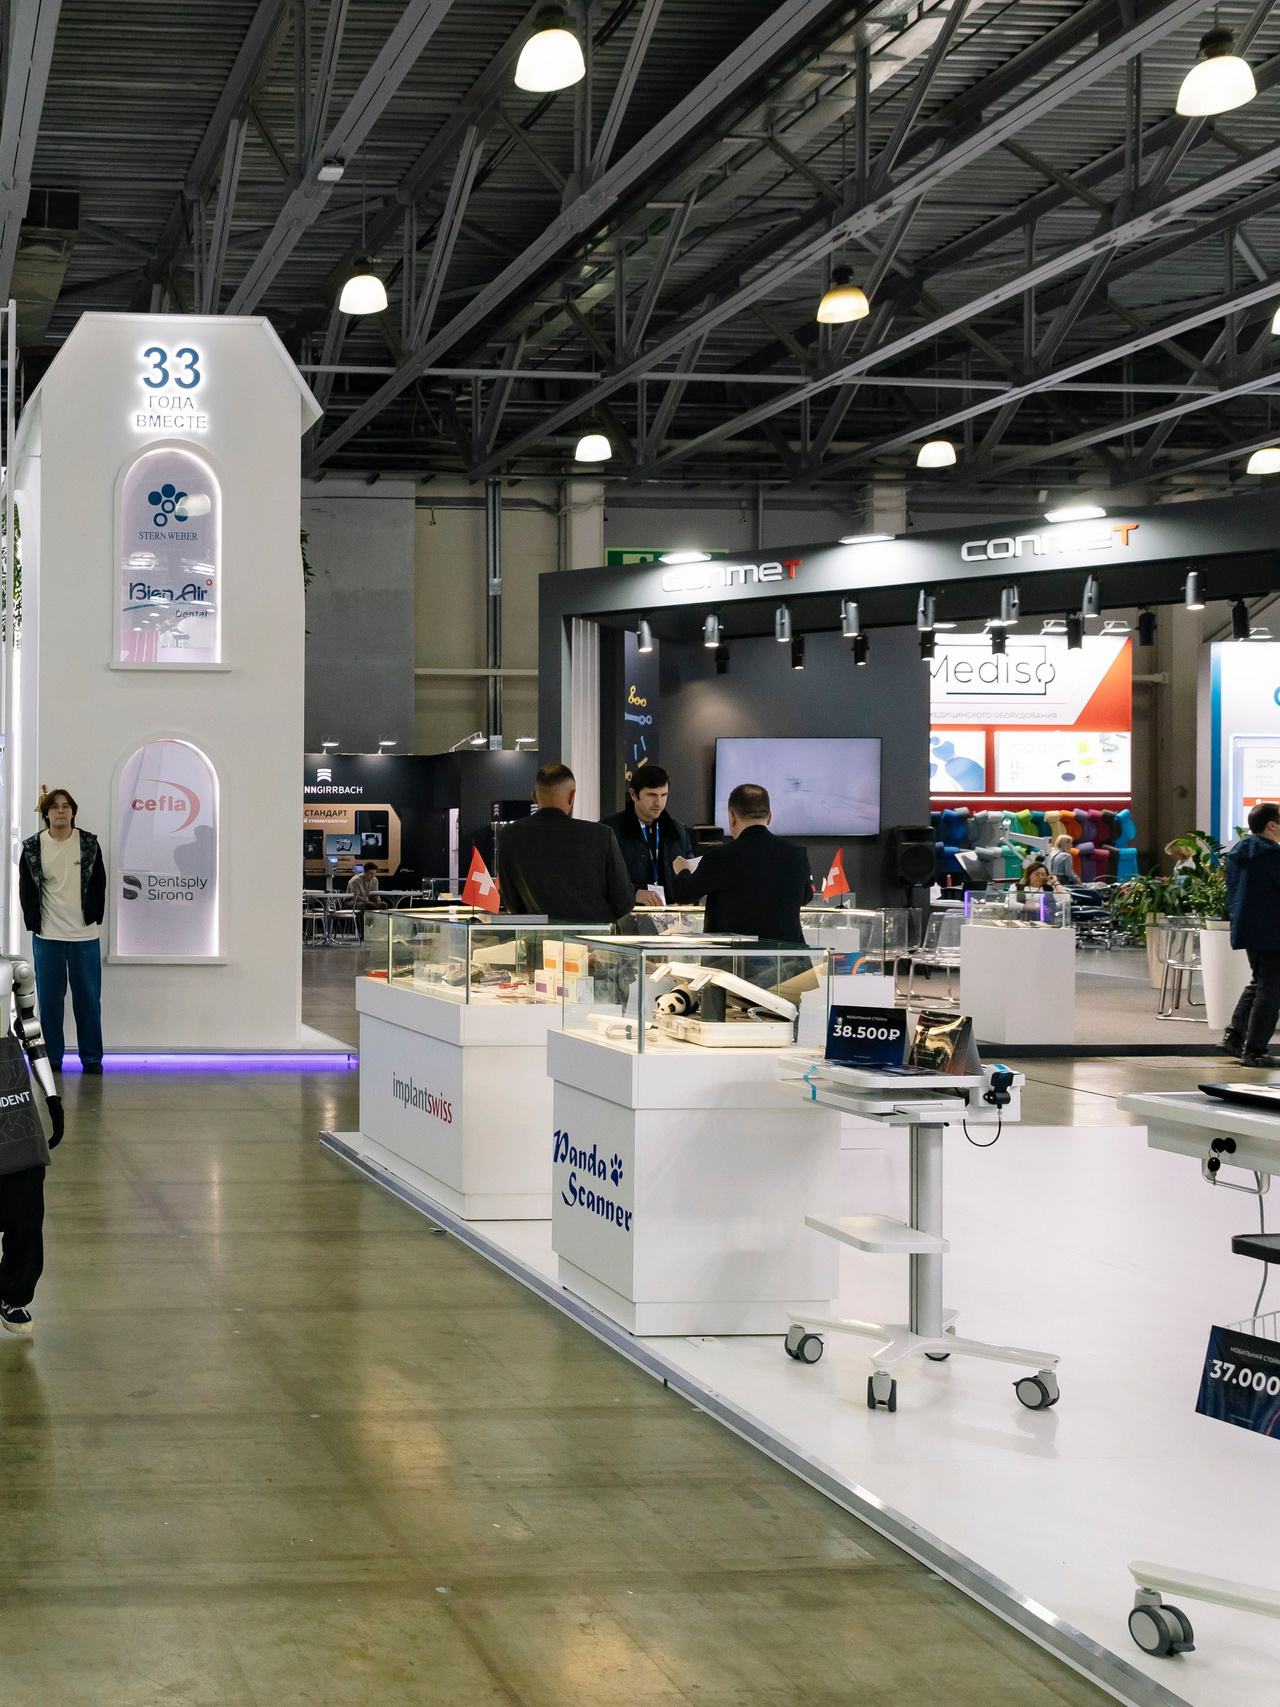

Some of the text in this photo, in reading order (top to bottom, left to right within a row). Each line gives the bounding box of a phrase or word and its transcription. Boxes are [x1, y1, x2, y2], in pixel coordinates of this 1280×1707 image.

[142, 346, 201, 389] 33
[149, 395, 194, 411] ГОДА
[136, 414, 206, 430] ВМЕСТЕ
[138, 531, 198, 541] STERN WEBER
[175, 610, 207, 618] Dental
[930, 711, 1058, 720] ЕДИЦИНСКОГО ОБОРУДОВАНИЯ
[304, 785, 363, 794] NNGIRRBACH
[131, 795, 187, 812] cefla
[304, 809, 348, 818] СТАНДАРТ
[147, 875, 208, 890] Dentsply
[147, 888, 194, 901] Sirona
[832, 1024, 901, 1041] 38.500₽
[0, 1091, 30, 1108] IDENT
[392, 1071, 453, 1124] implantswiss
[553, 1129, 607, 1181] Panda
[561, 1171, 633, 1232] Scanner
[1230, 1346, 1263, 1361] МОБИЛЬНАЯ
